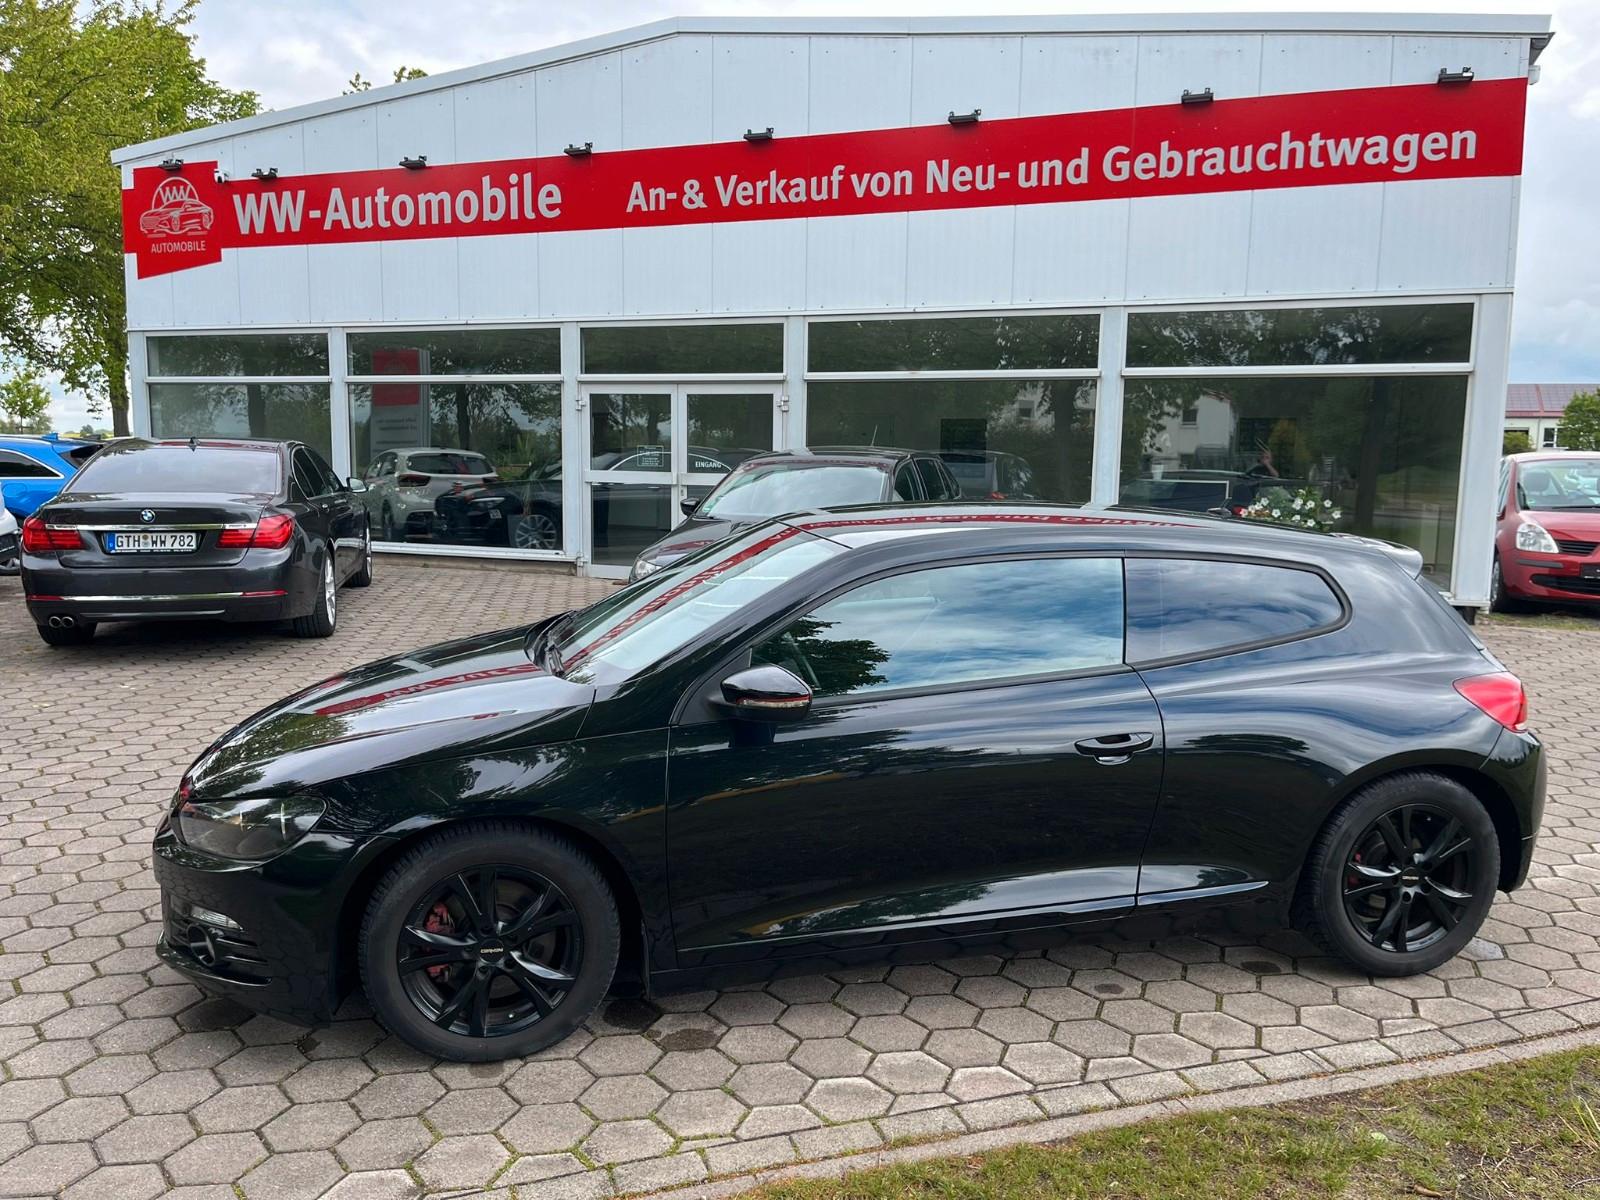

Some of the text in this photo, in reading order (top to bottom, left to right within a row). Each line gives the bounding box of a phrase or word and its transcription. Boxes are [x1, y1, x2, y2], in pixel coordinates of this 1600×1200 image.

[682, 179, 708, 210] &
[714, 165, 846, 207] Verkauf
[850, 169, 913, 199] von
[1017, 147, 1089, 189] und
[1102, 130, 1477, 182] Gebrauchtwagen
[233, 172, 562, 235] WW-Automobile
[151, 240, 206, 253] AUTOMOBILE
[116, 535, 140, 548] GTH
[151, 535, 167, 548] WW
[170, 534, 194, 548] 782
